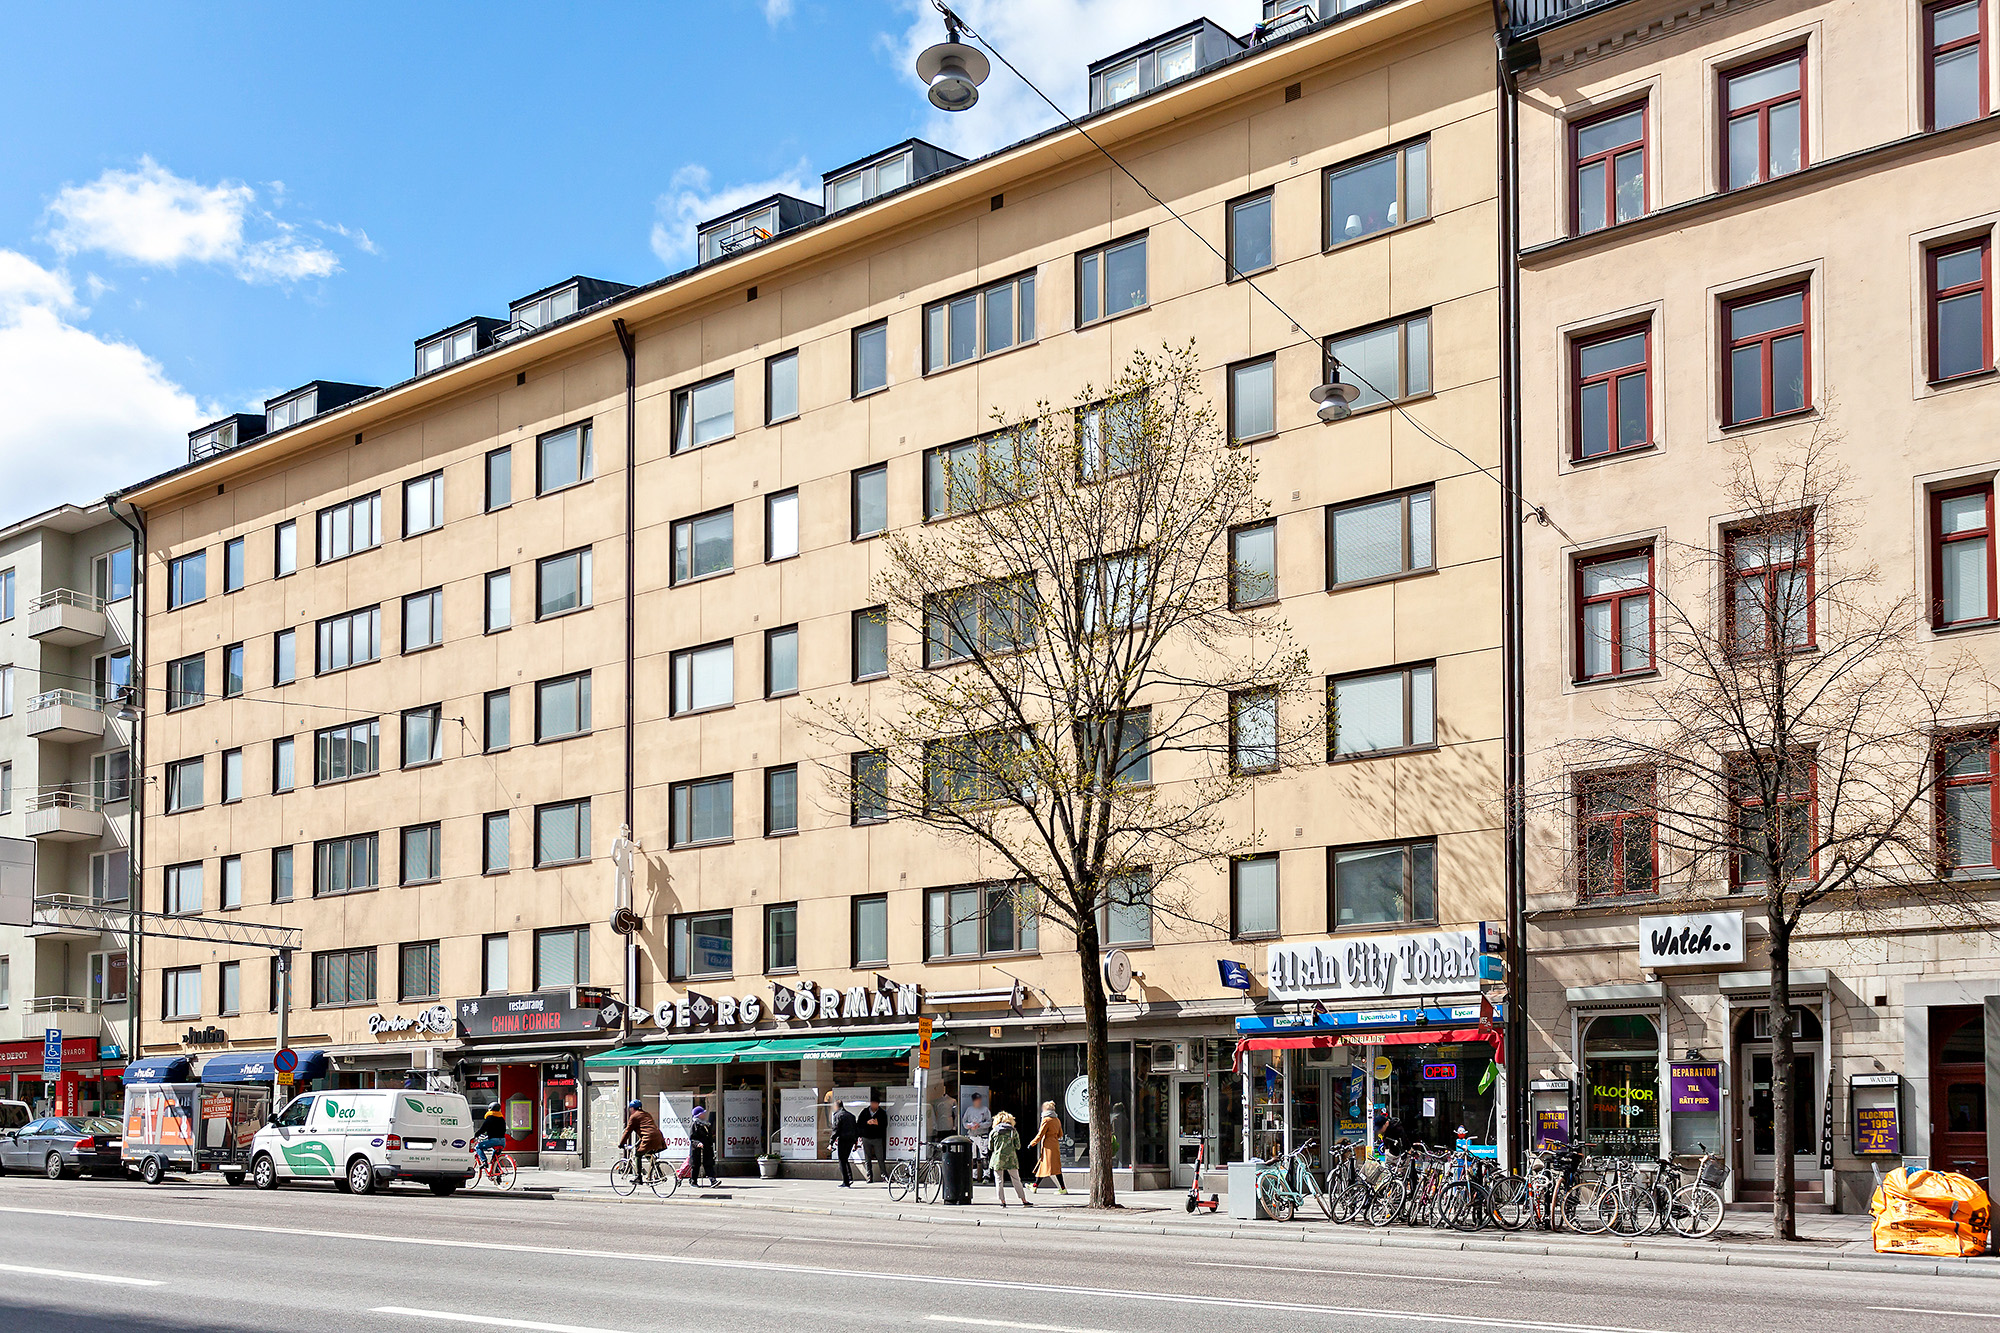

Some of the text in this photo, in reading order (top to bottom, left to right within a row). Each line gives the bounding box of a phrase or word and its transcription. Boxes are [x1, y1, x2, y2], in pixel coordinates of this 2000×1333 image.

[1342, 940, 1393, 994] City
[1397, 934, 1476, 981] Tobak
[508, 1000, 544, 1011] restaurang
[653, 980, 919, 1028] GERG ÖRMAN
[1360, 1013, 1398, 1022] Lycamobile
[367, 1012, 414, 1035] Barber
[491, 1012, 561, 1033] CHINA CORNER
[49, 1030, 59, 1042] P
[6, 1051, 28, 1060] DEPOT
[802, 1051, 843, 1060] GEORG SÖRMAN
[1425, 1066, 1455, 1077] OPEN
[1672, 1067, 1717, 1078] REPARATION
[1687, 1084, 1700, 1092] TILL
[1593, 1085, 1654, 1101] KLOCKOR
[1679, 1096, 1694, 1104] RÄTT
[783, 1115, 815, 1123] KONKURS
[1539, 1112, 1565, 1121] BATTERI
[1859, 1110, 1895, 1120] KLOCKOR
[1340, 1122, 1367, 1130] JACKPOT
[1543, 1121, 1559, 1130] BYTE
[727, 1136, 760, 1145] 50-70%
[783, 1137, 815, 1146] 50-70%
